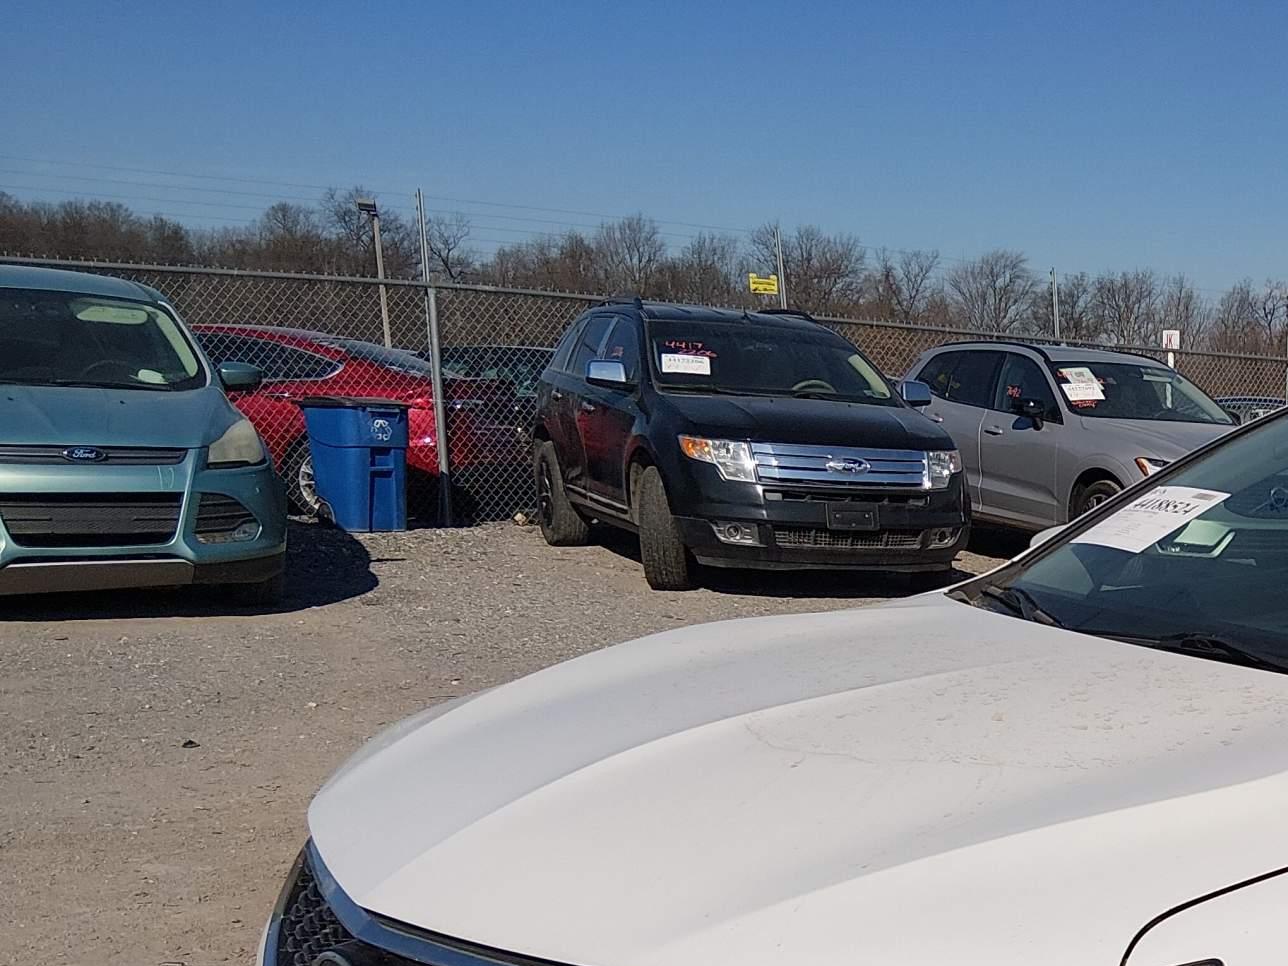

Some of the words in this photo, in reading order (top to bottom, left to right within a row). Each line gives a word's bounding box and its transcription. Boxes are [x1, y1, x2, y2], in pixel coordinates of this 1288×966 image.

[665, 341, 704, 349] 4417
[73, 449, 97, 459] Ford
[1133, 498, 1200, 515] 44188524
